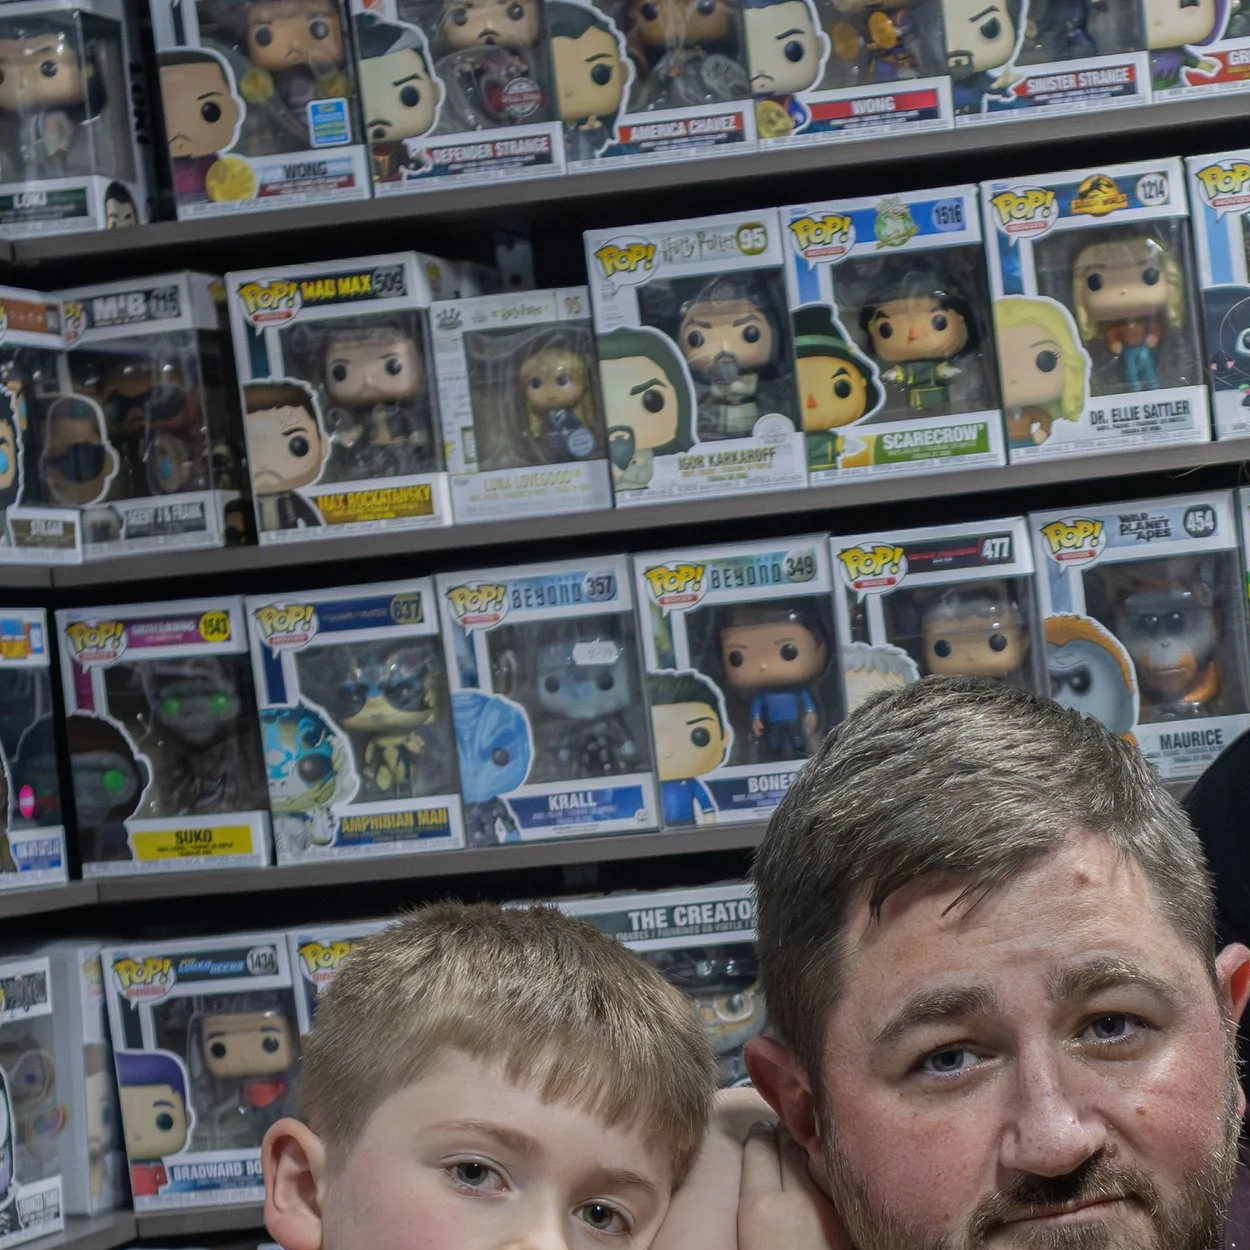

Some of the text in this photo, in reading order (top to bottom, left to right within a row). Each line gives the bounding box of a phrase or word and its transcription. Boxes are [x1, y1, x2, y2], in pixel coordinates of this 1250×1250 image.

[1027, 66, 1131, 94] SINISTER STRANGE
[851, 96, 896, 115] WONG
[630, 114, 737, 142] AMERICA CHAVEZ
[431, 135, 549, 164] DEFENDER STRANGE
[282, 161, 327, 179] WONG
[1141, 179, 1166, 200] 1214
[936, 206, 963, 227] 1516
[992, 189, 1056, 223] POP!
[739, 226, 765, 251] 95
[790, 214, 852, 250] POP!
[596, 243, 657, 278] POP!
[239, 281, 299, 314] POP!
[301, 274, 371, 299] MAD MAX
[1089, 400, 1190, 426] DR. ELLIE SATTLER
[882, 429, 979, 451] SCARECROW
[1186, 510, 1215, 531] 454
[982, 536, 1010, 559] 477
[1041, 519, 1105, 554] POP!
[711, 563, 782, 590] BEYOND
[786, 556, 815, 577] 349
[838, 546, 904, 581] POP!
[587, 574, 613, 595] 357
[643, 561, 706, 594] POP!
[446, 583, 507, 618] POP!
[512, 583, 581, 609] BEYOND
[253, 603, 315, 638] POP!
[65, 620, 124, 654] POP!
[1159, 728, 1223, 750] MAURICE
[548, 790, 598, 811] KRALL
[341, 808, 448, 834] AMPHIBIAN MAN
[175, 830, 213, 844] SUKO
[628, 899, 751, 930] THE CREATO
[298, 941, 350, 974] POP
[112, 957, 172, 988] POP!
[173, 1163, 242, 1182] BRADWARD
